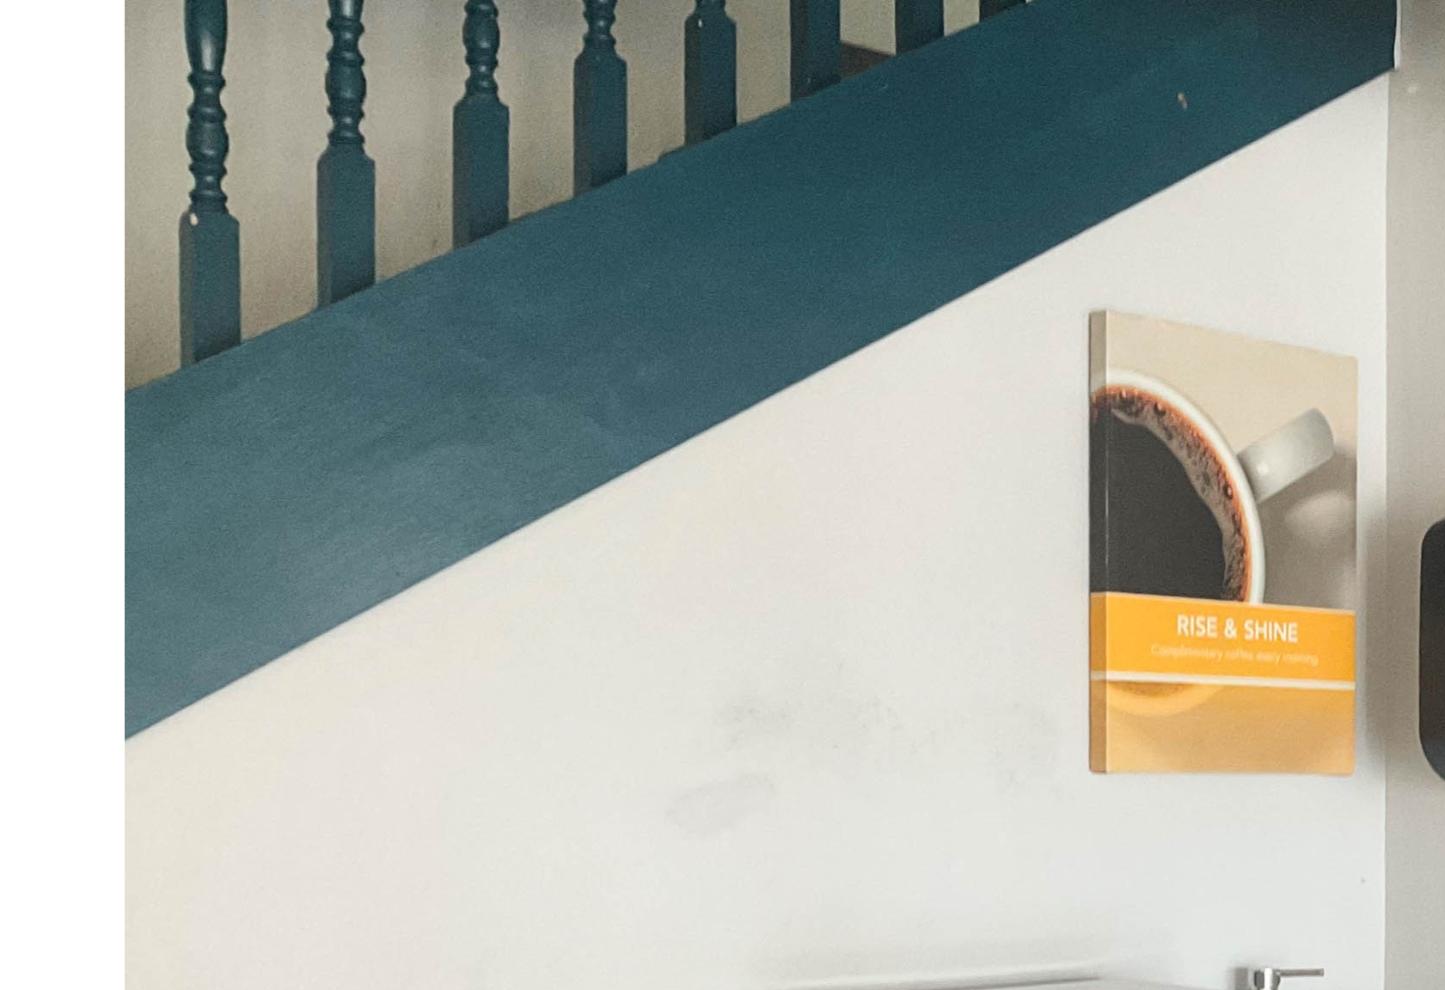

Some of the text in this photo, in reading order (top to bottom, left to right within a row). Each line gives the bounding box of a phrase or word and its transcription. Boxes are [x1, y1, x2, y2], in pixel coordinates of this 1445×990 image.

[1176, 613, 1299, 643] RISE & SHINE
